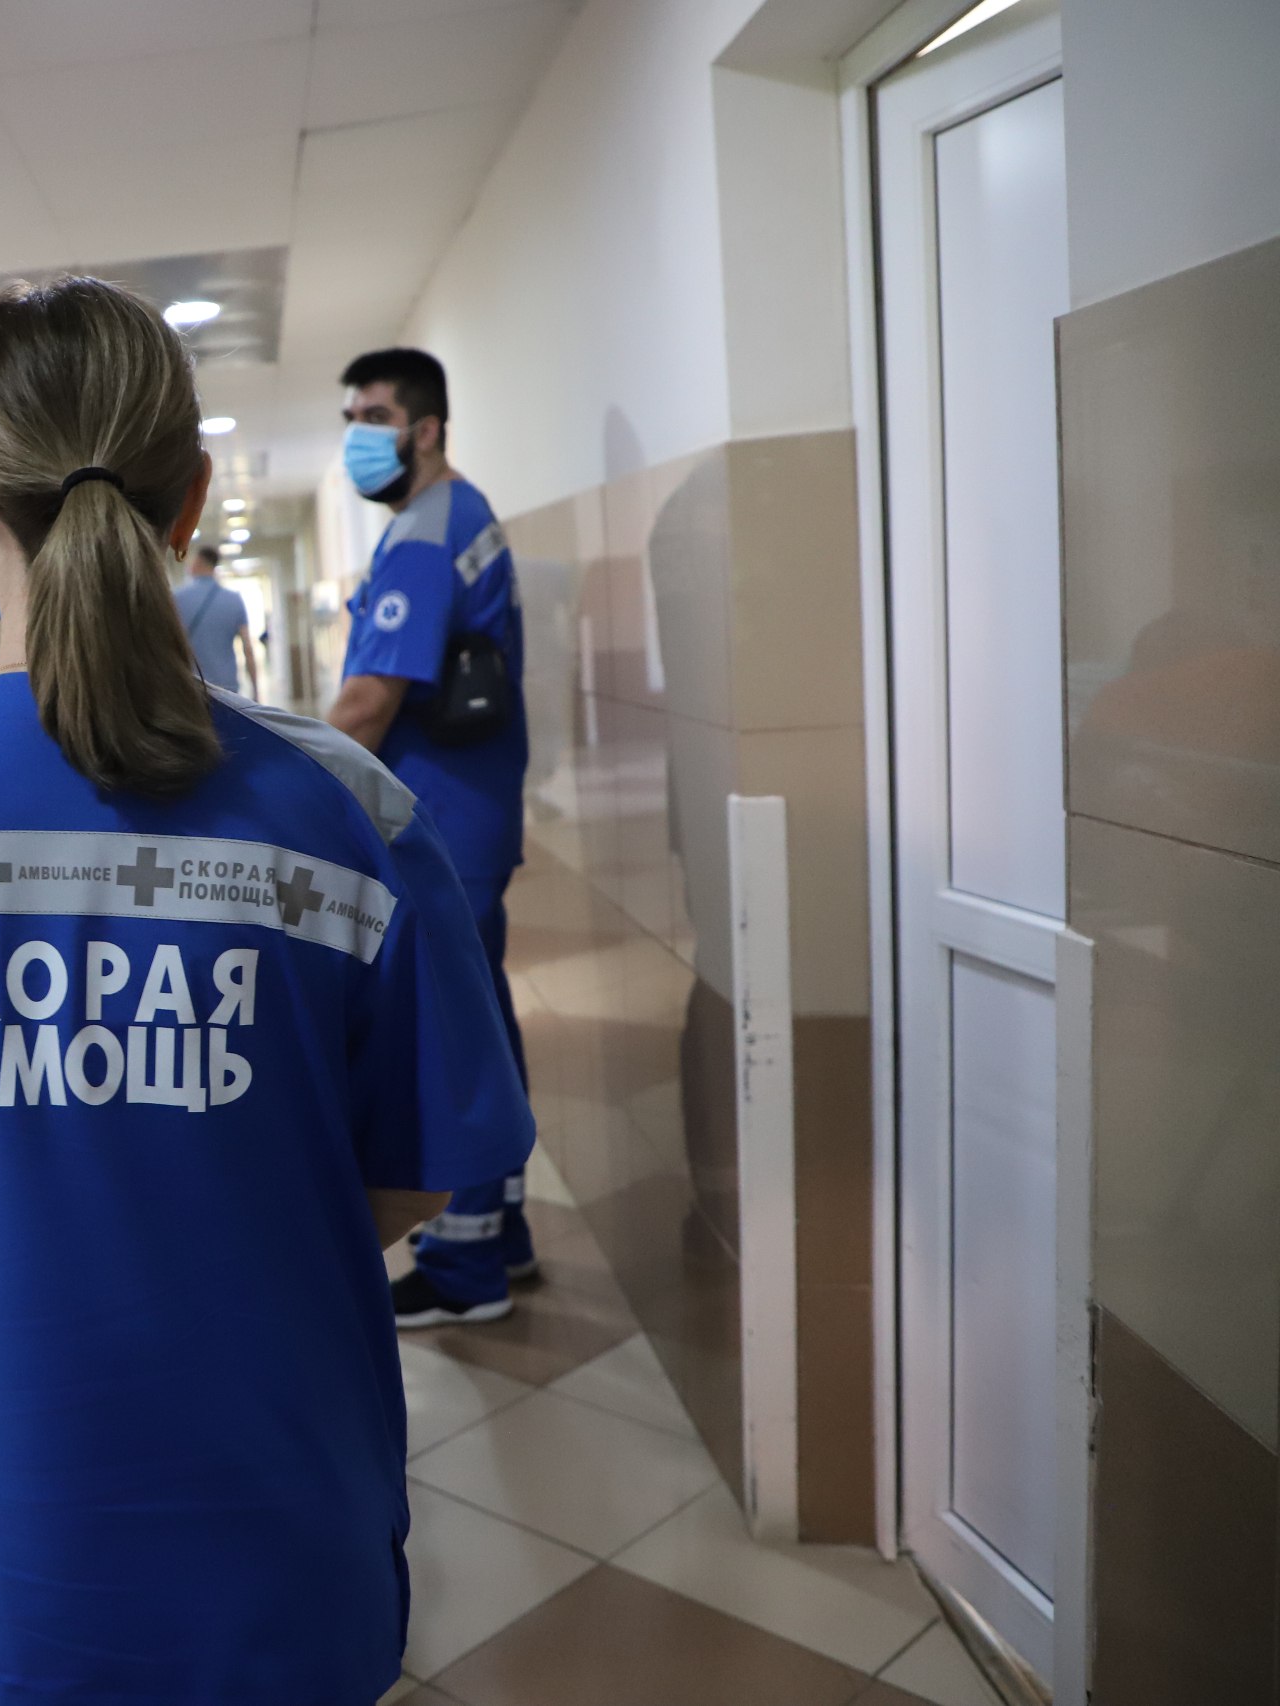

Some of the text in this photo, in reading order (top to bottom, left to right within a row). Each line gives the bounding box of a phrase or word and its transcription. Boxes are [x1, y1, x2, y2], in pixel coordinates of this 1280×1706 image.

[18, 866, 111, 881] AMBULANCE
[180, 859, 276, 885] СКОРАЯ
[178, 881, 275, 908] ПОМОЩЬ
